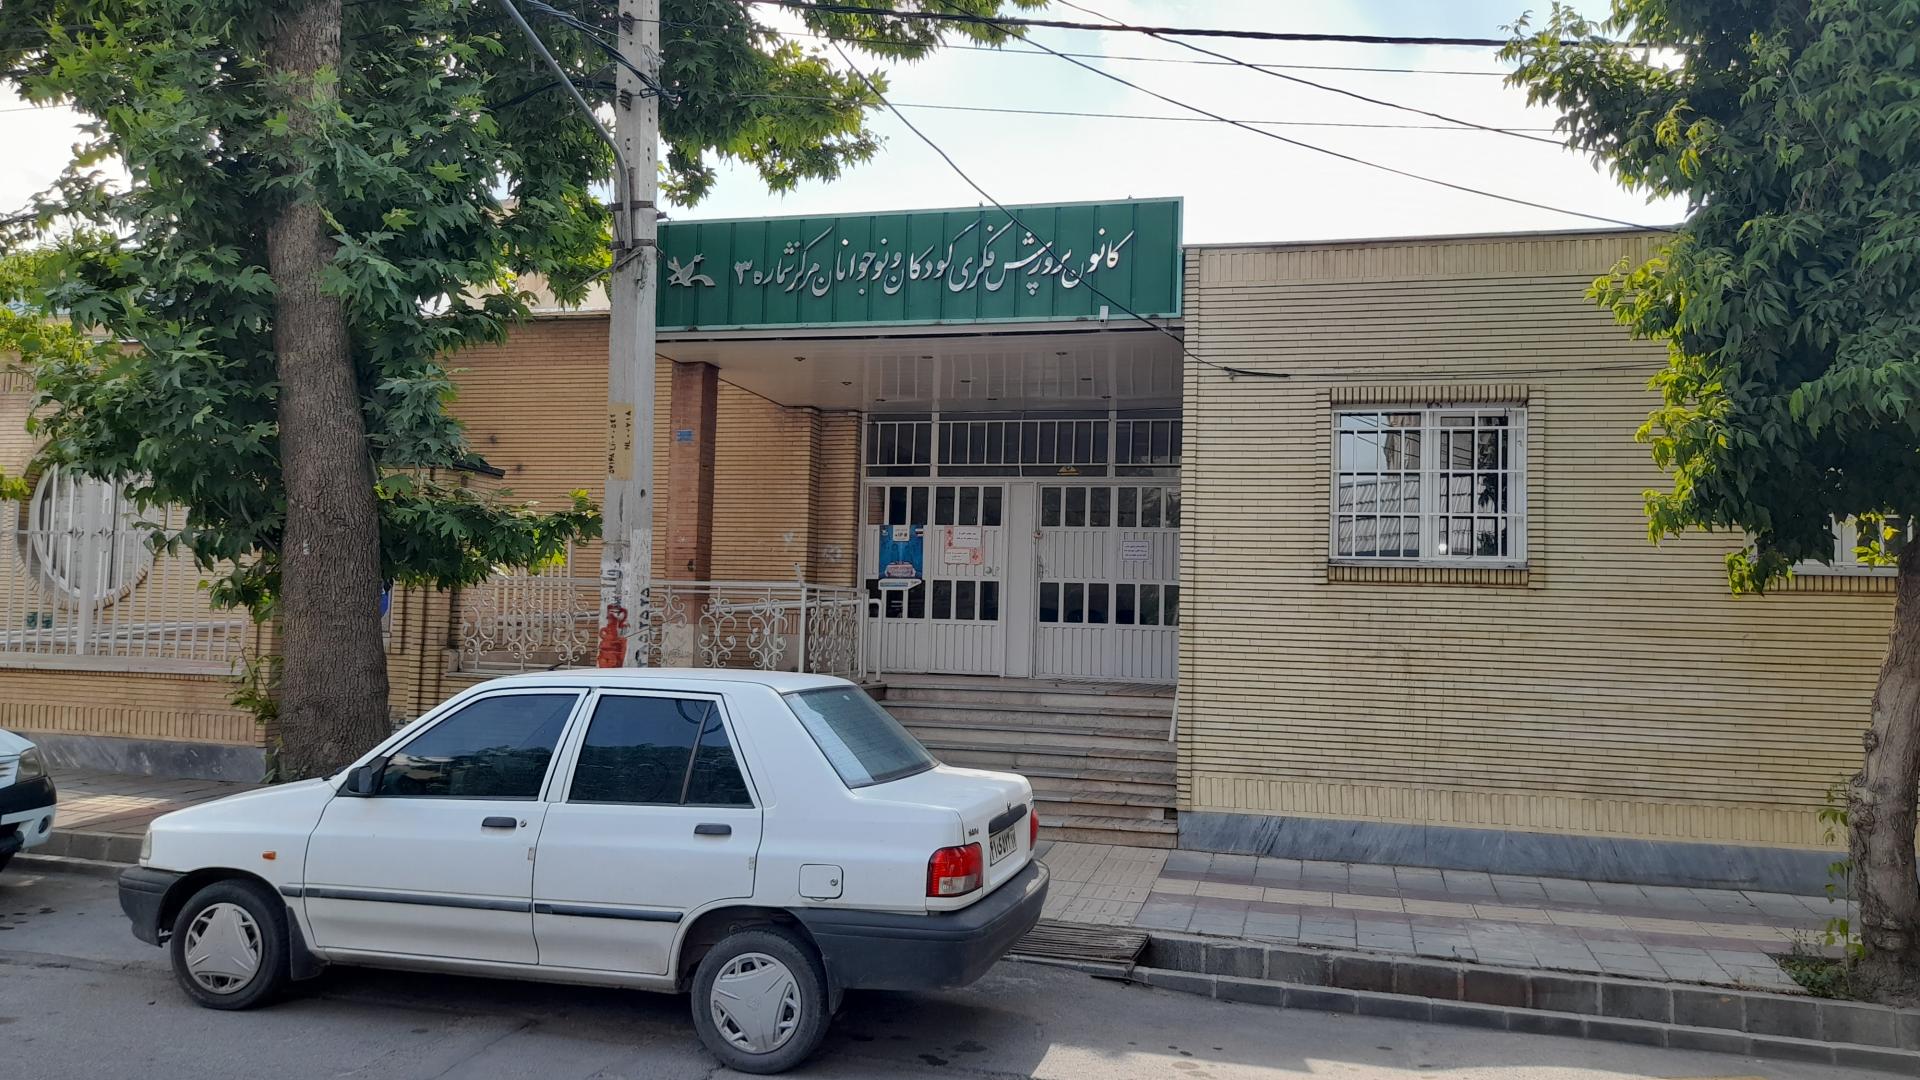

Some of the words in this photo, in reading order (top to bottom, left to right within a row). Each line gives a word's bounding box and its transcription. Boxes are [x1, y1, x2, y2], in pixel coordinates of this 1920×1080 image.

[734, 258, 754, 285] ۳
[754, 241, 795, 285] شماره
[785, 226, 832, 292] مرکز
[812, 238, 889, 297] نوجوانان
[883, 218, 981, 295] کودکان
[890, 252, 902, 269] و
[949, 220, 1014, 292] فکری
[985, 231, 1071, 296] پرورش
[1061, 228, 1134, 289] کانون
